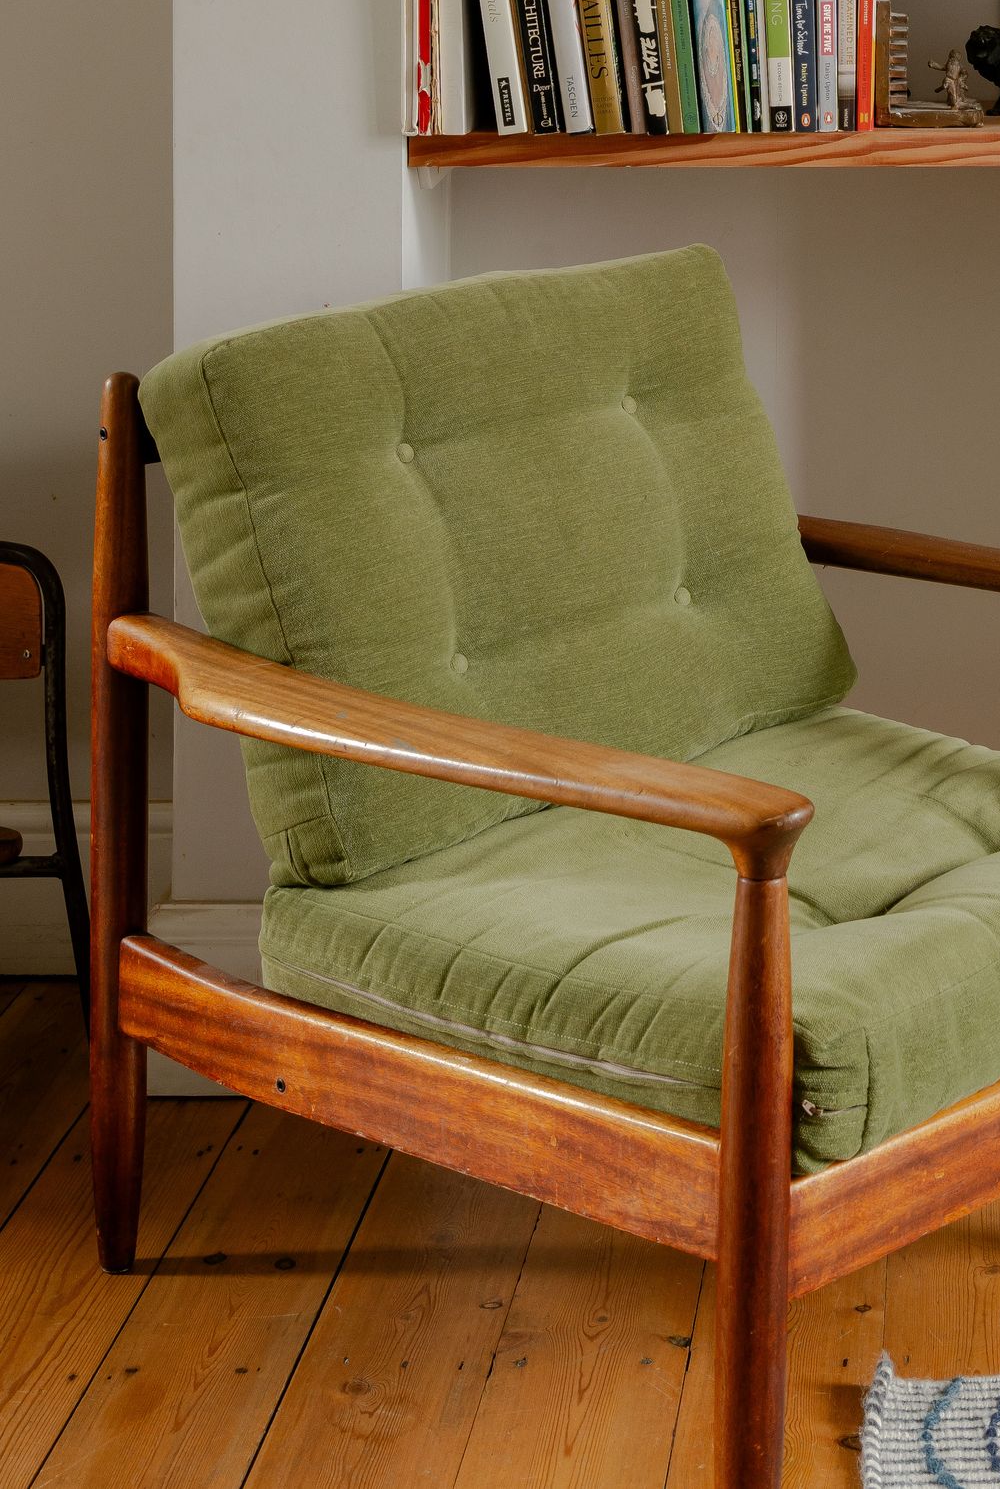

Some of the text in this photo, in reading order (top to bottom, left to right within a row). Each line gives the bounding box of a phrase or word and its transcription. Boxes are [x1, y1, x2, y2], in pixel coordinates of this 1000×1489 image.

[822, 4, 832, 21] GIVE
[823, 23, 832, 34] ME
[823, 35, 833, 53] FIVE
[566, 75, 579, 118] TASCHEN
[800, 63, 810, 106] Daisy Upton
[502, 89, 513, 122] PRESTEL
